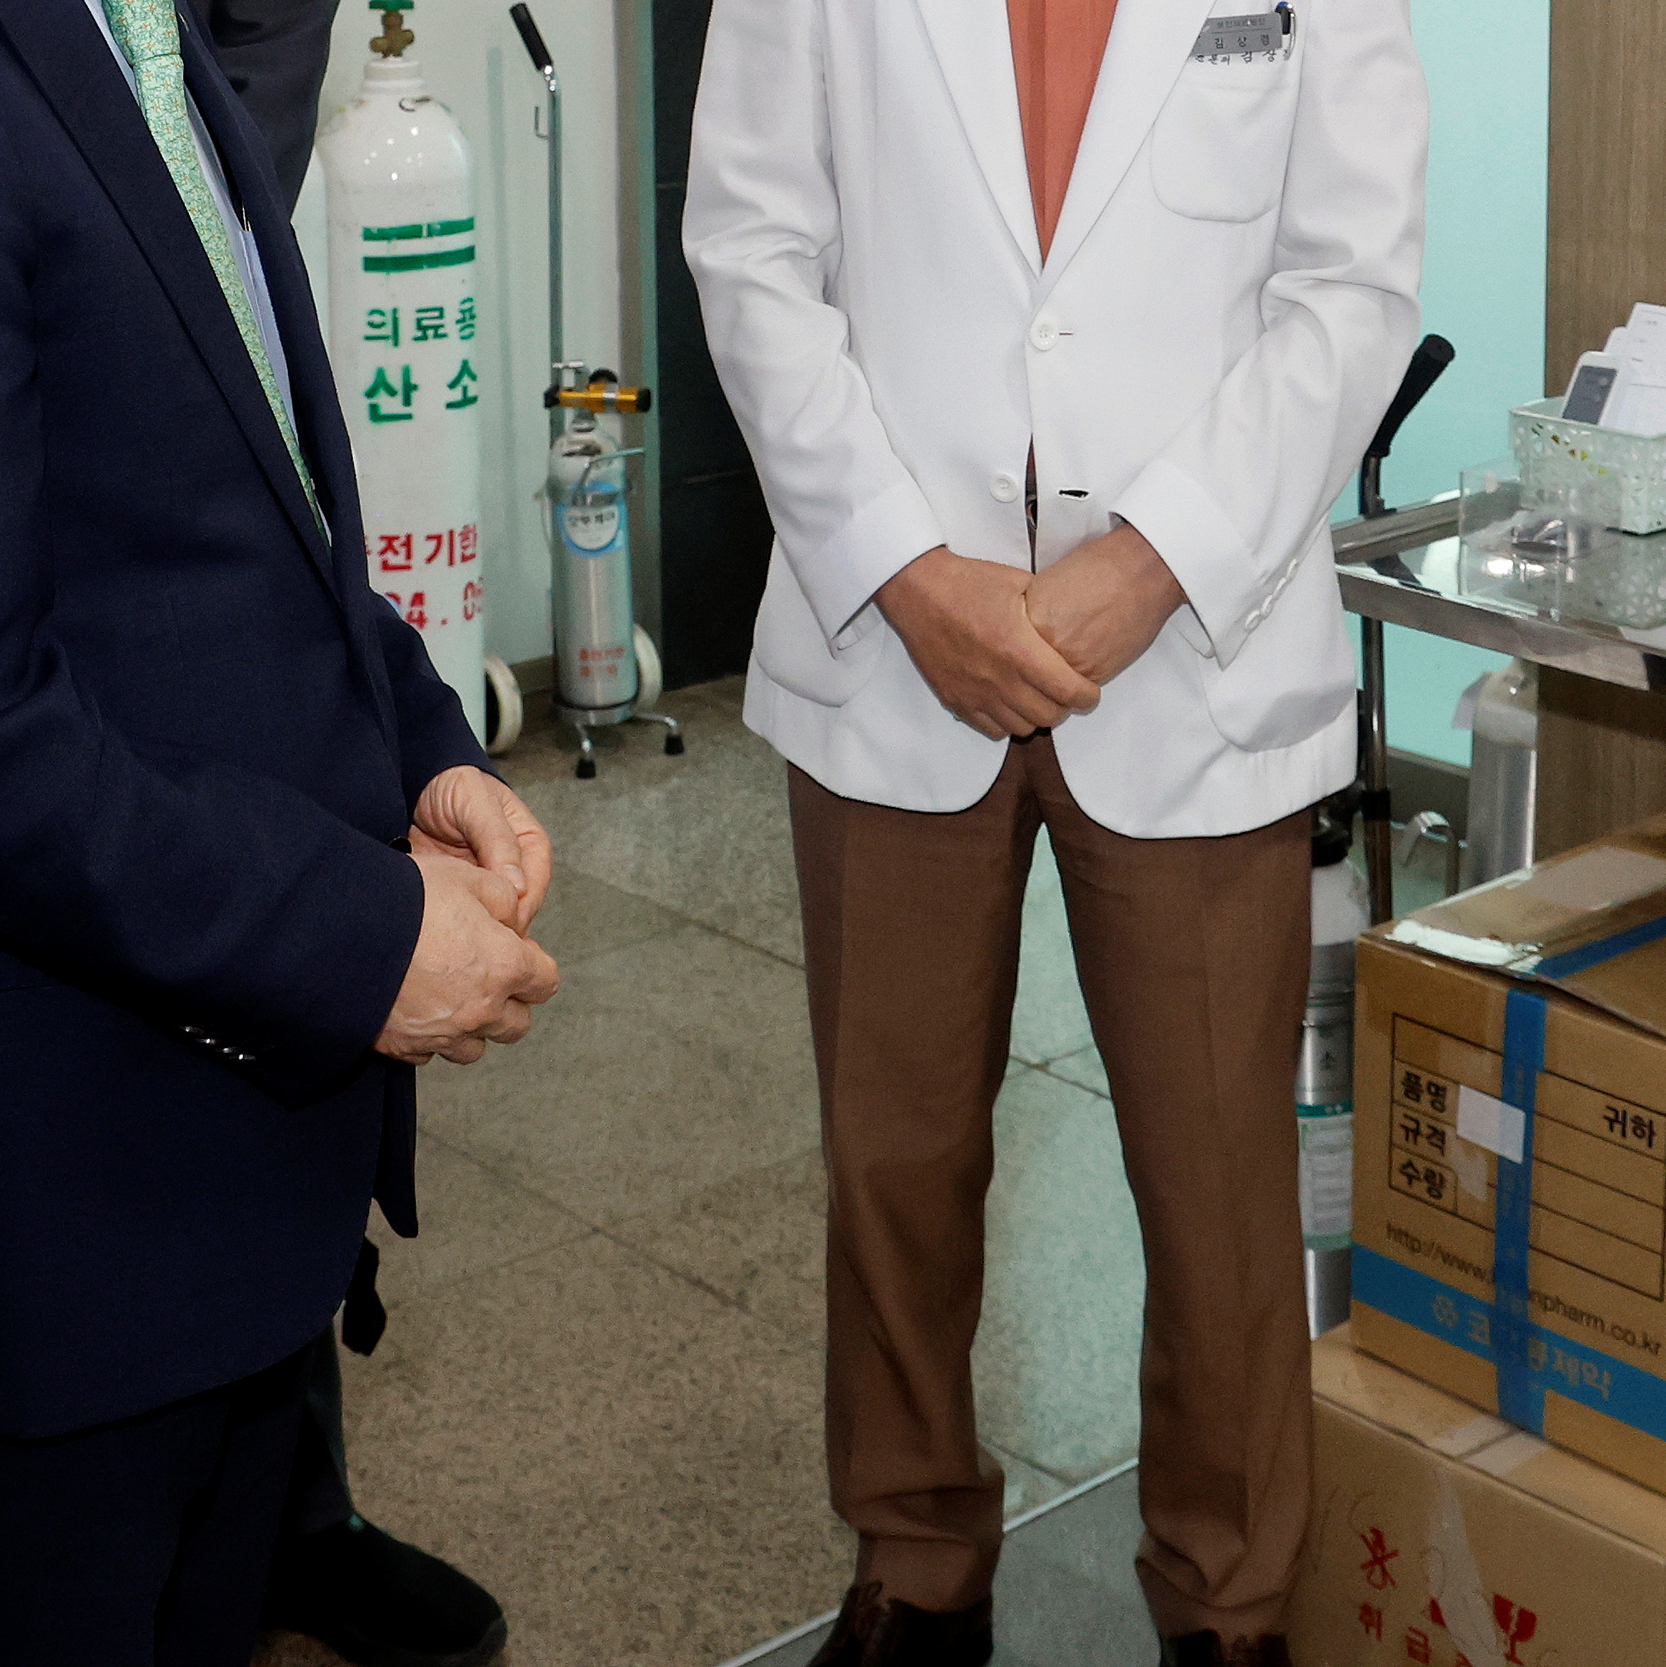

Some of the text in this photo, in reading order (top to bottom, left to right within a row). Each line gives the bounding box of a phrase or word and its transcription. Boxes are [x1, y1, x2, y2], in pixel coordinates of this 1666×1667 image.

[363, 296, 477, 348] 의료용
[364, 522, 478, 572] 전기한
[1401, 1070, 1448, 1115] 품명
[1399, 1112, 1447, 1157] 규격
[1603, 1104, 1655, 1150] 귀하
[1398, 1159, 1448, 1202] 수량
